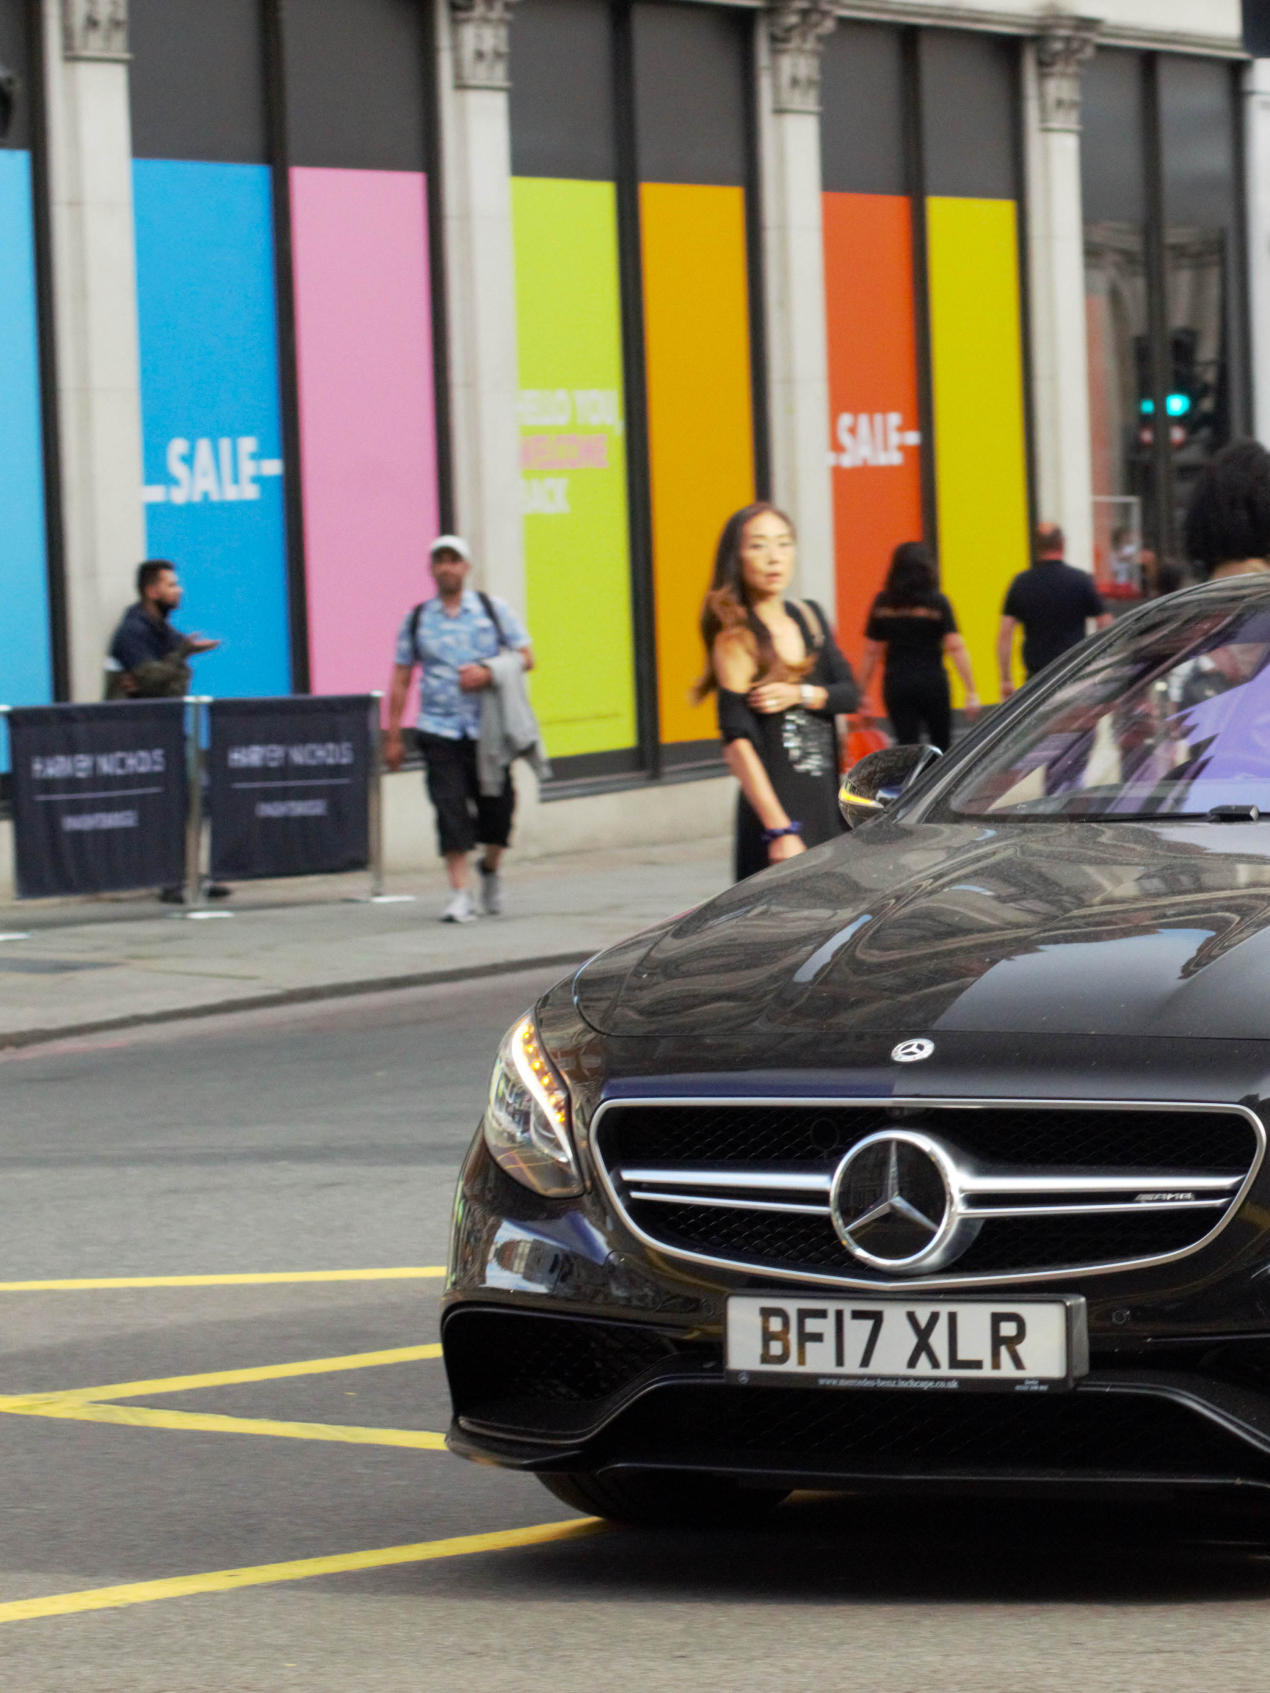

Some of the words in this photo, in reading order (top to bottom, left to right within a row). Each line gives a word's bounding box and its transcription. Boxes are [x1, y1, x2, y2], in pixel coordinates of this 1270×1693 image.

[167, 436, 259, 504] SALE
[837, 412, 903, 468] SALE
[759, 1306, 884, 1369] BF17
[906, 1310, 1026, 1370] XLR
